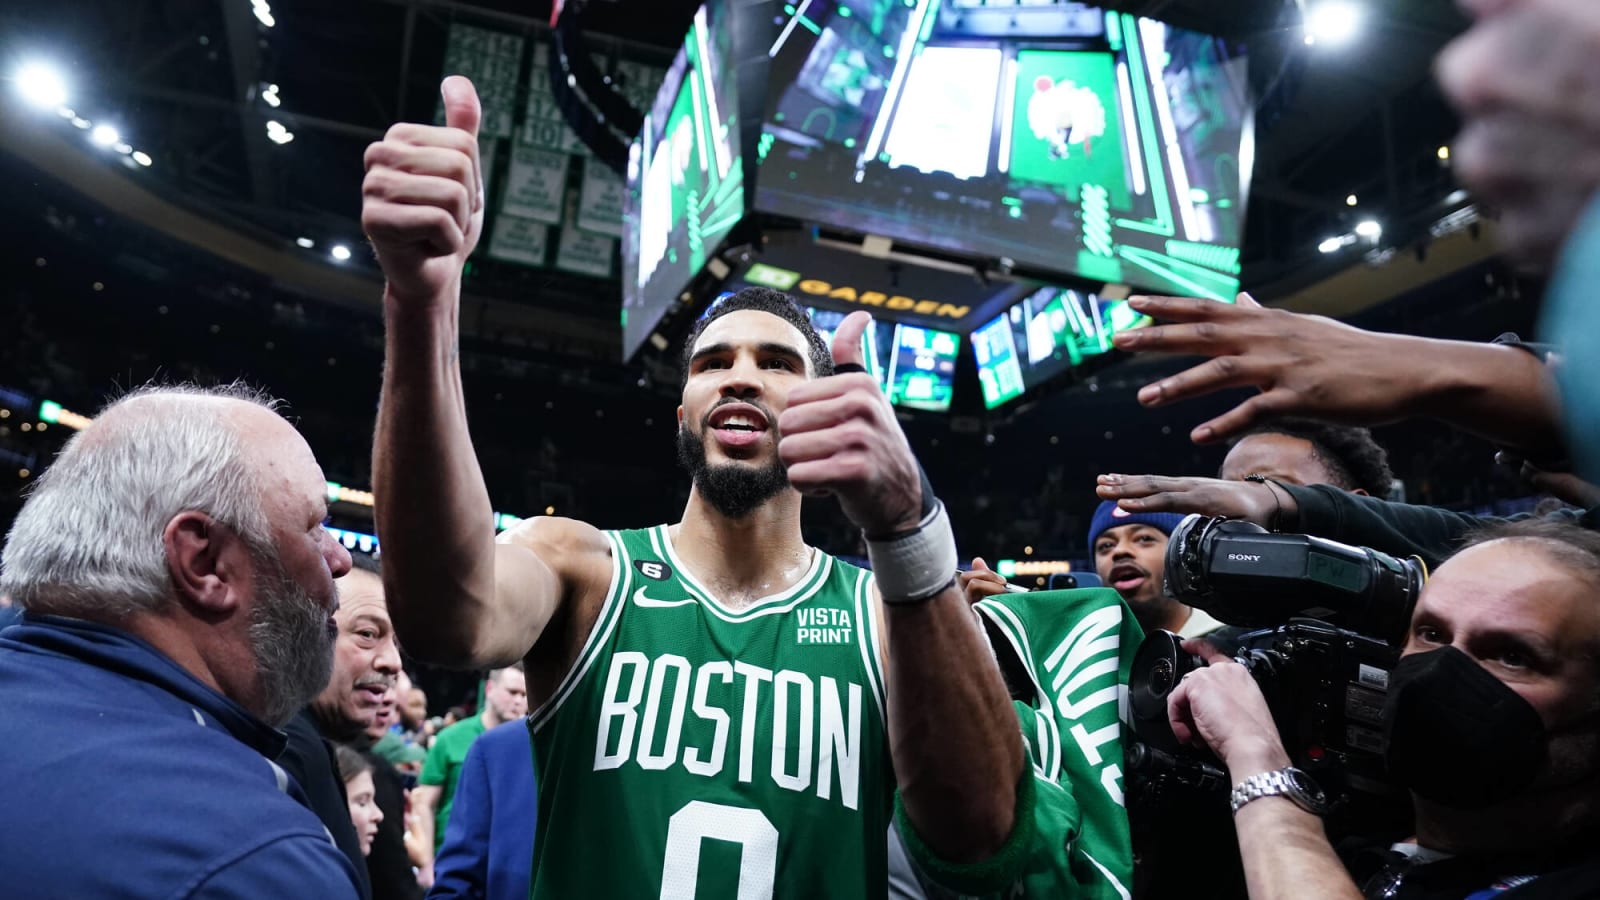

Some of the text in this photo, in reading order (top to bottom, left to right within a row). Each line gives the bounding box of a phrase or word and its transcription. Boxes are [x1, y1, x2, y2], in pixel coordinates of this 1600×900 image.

[799, 279, 970, 318] GARDEN
[1227, 553, 1261, 562] SONY
[641, 563, 663, 579] 6
[1314, 558, 1345, 577] PW
[797, 607, 851, 627] VISTA
[797, 628, 852, 644] PRINT
[593, 651, 862, 811] BOSTON
[659, 800, 779, 900] 0
